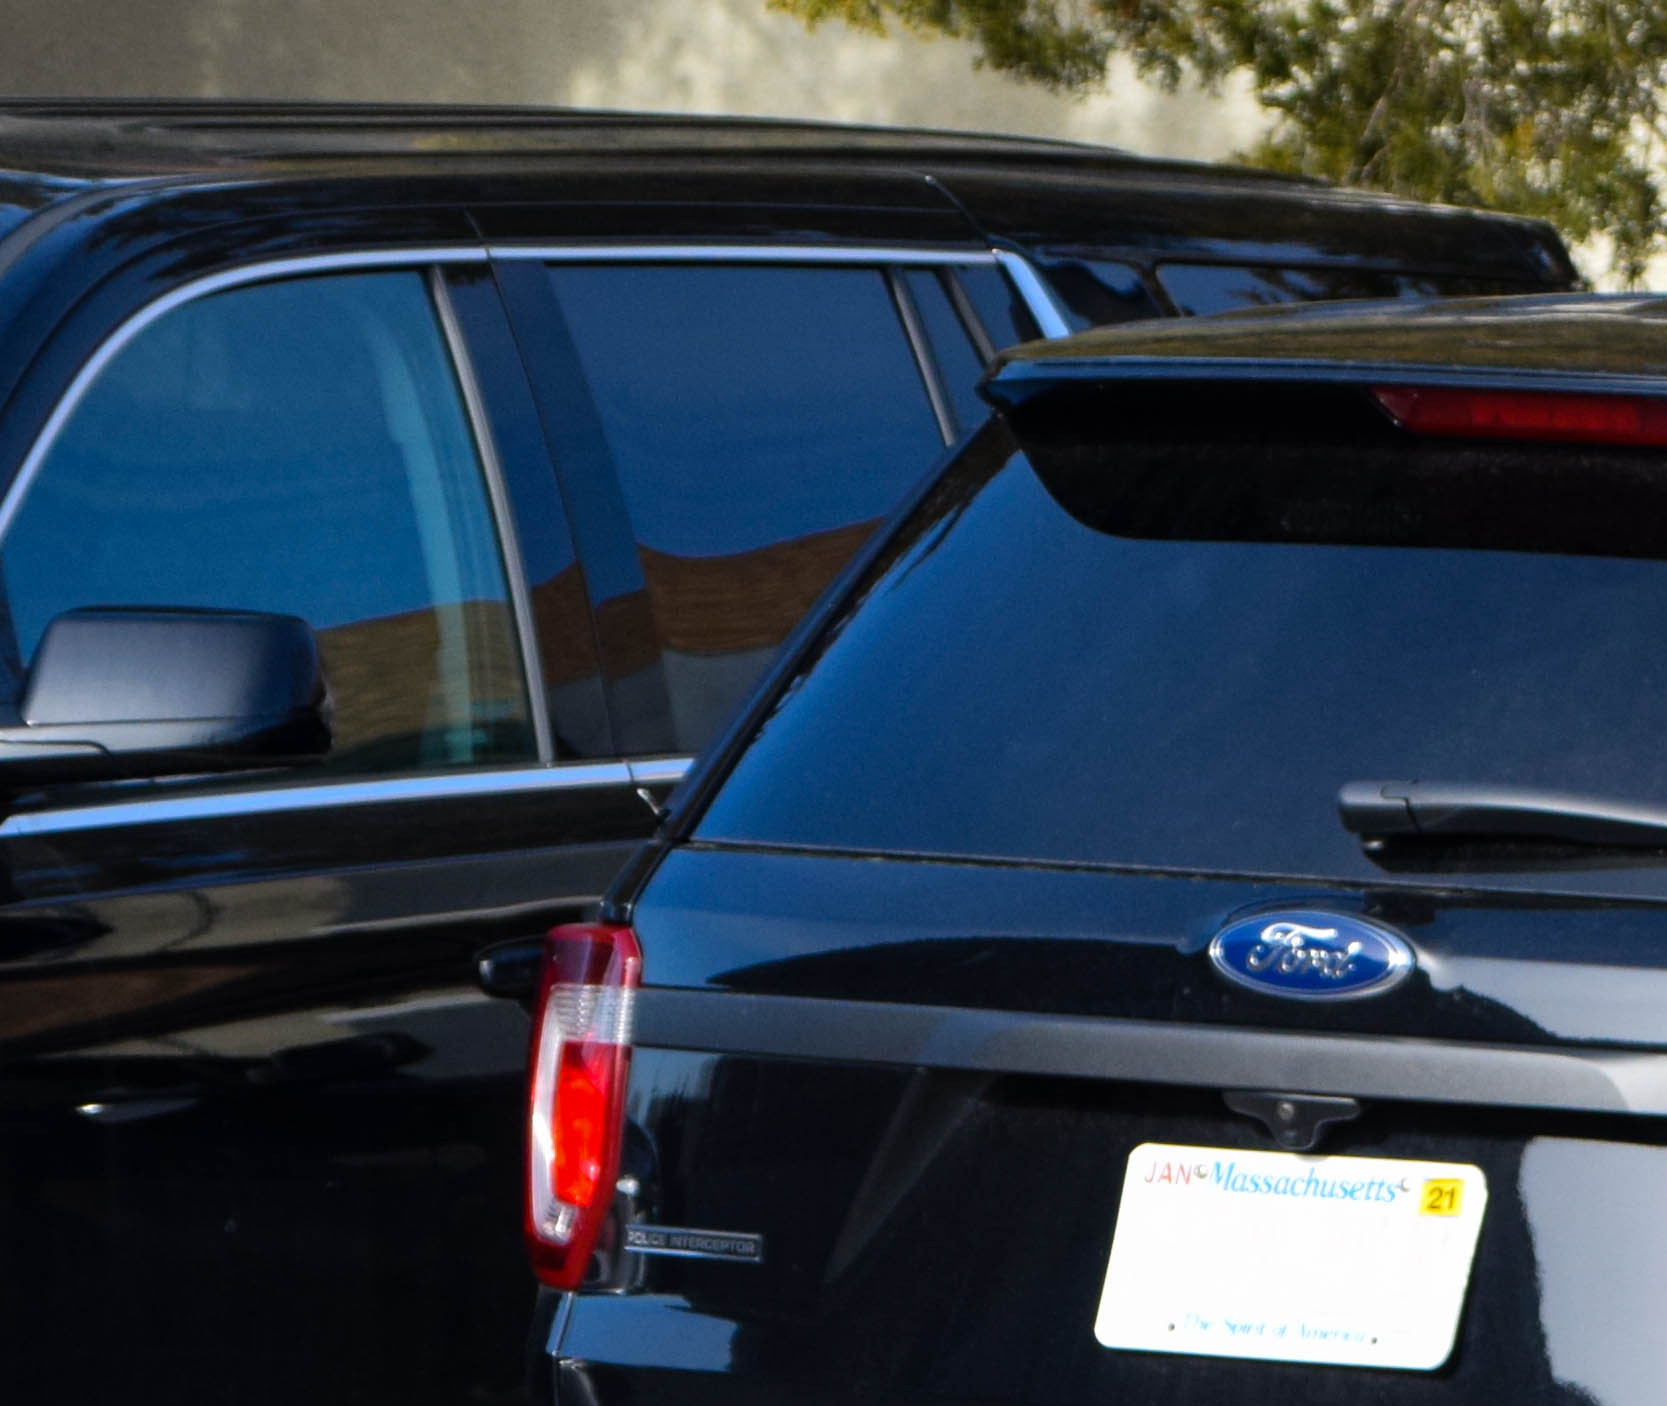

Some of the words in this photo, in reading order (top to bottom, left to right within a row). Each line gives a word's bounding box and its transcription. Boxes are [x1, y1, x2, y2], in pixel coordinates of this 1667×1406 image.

[1247, 921, 1362, 978] Ford
[1144, 1161, 1192, 1185] JAN
[1209, 1160, 1398, 1203] Massachusetts
[1426, 1187, 1456, 1210] 21
